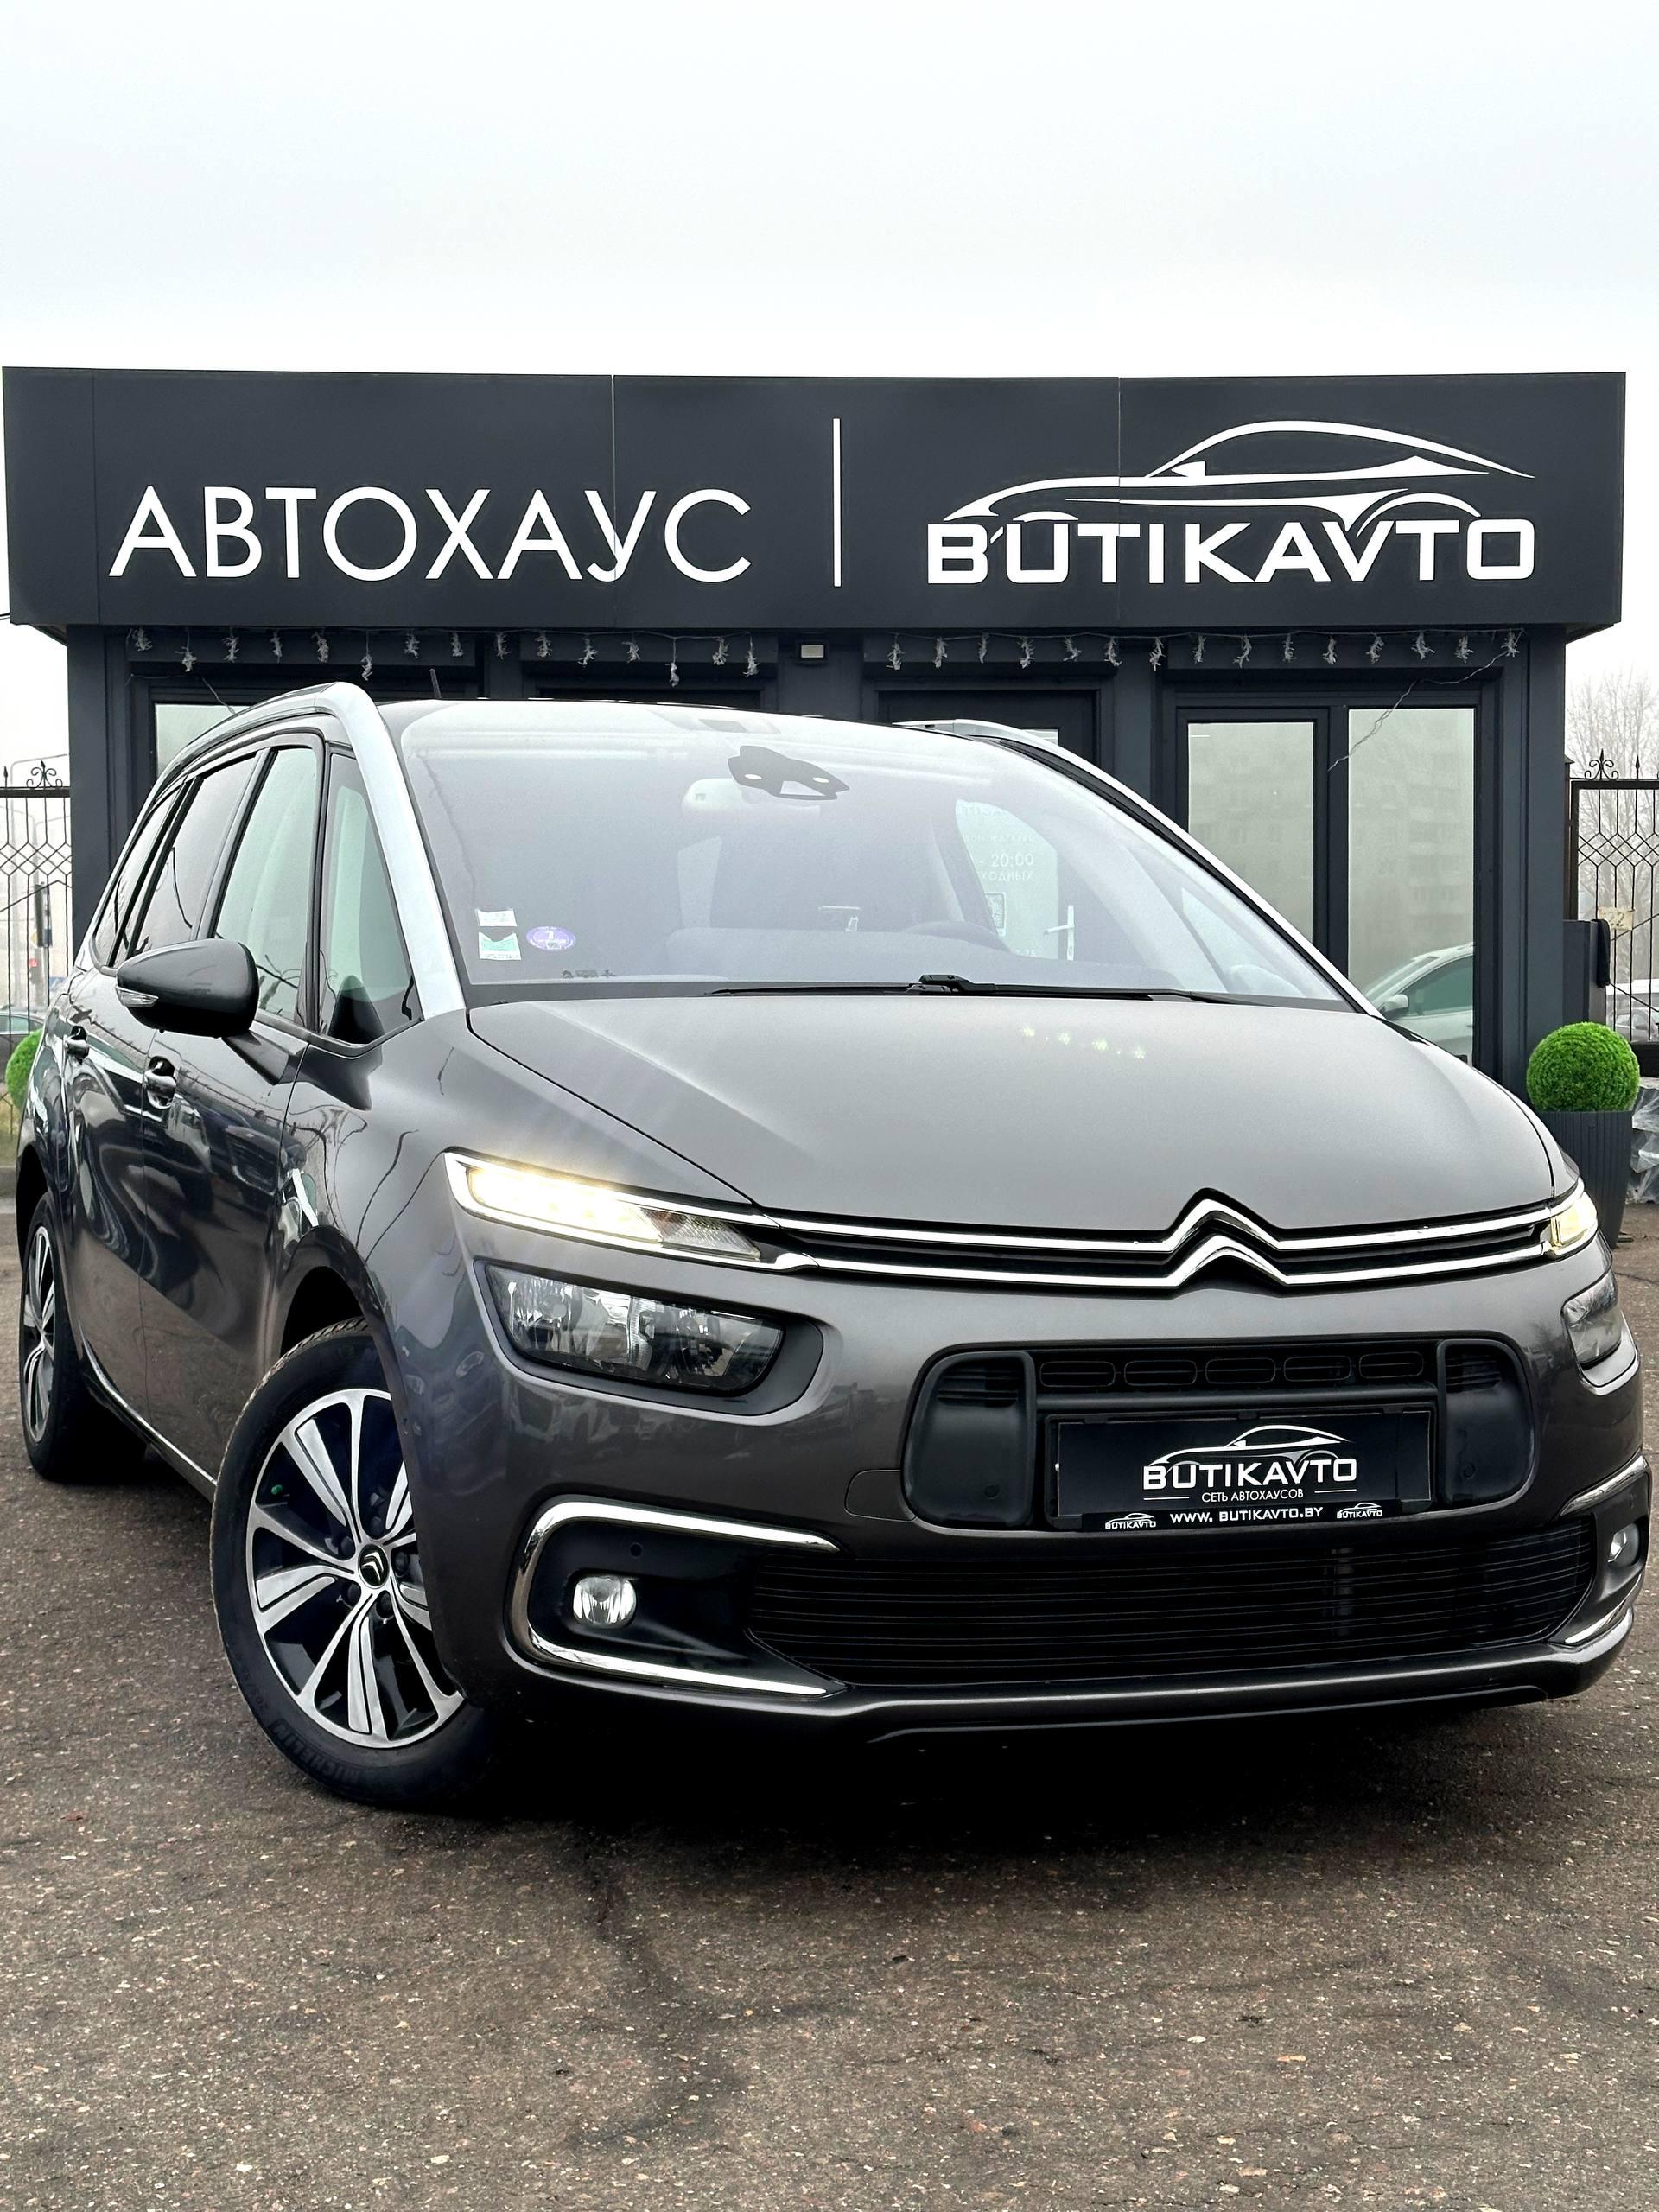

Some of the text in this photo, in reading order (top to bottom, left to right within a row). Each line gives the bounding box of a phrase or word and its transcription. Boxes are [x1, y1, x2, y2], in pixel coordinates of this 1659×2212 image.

[109, 486, 751, 582] АВТОХАУС
[927, 518, 1535, 584] BUTIKAVTO
[991, 853, 1033, 868] 20:00
[977, 870, 1033, 881] ХОДНЫХ
[1143, 1458, 1357, 1491] BUTIKAVTO
[1201, 1489, 1304, 1503] СЕТЬ АВТОХАУСОВ
[1169, 1507, 1324, 1524] WWW. BUTIKAVTO.BY
[1336, 1509, 1383, 1519] BUTIKAVTO
[1104, 1520, 1157, 1530] BUTIKAVTO
[272, 1722, 359, 1783] MICHELIN
